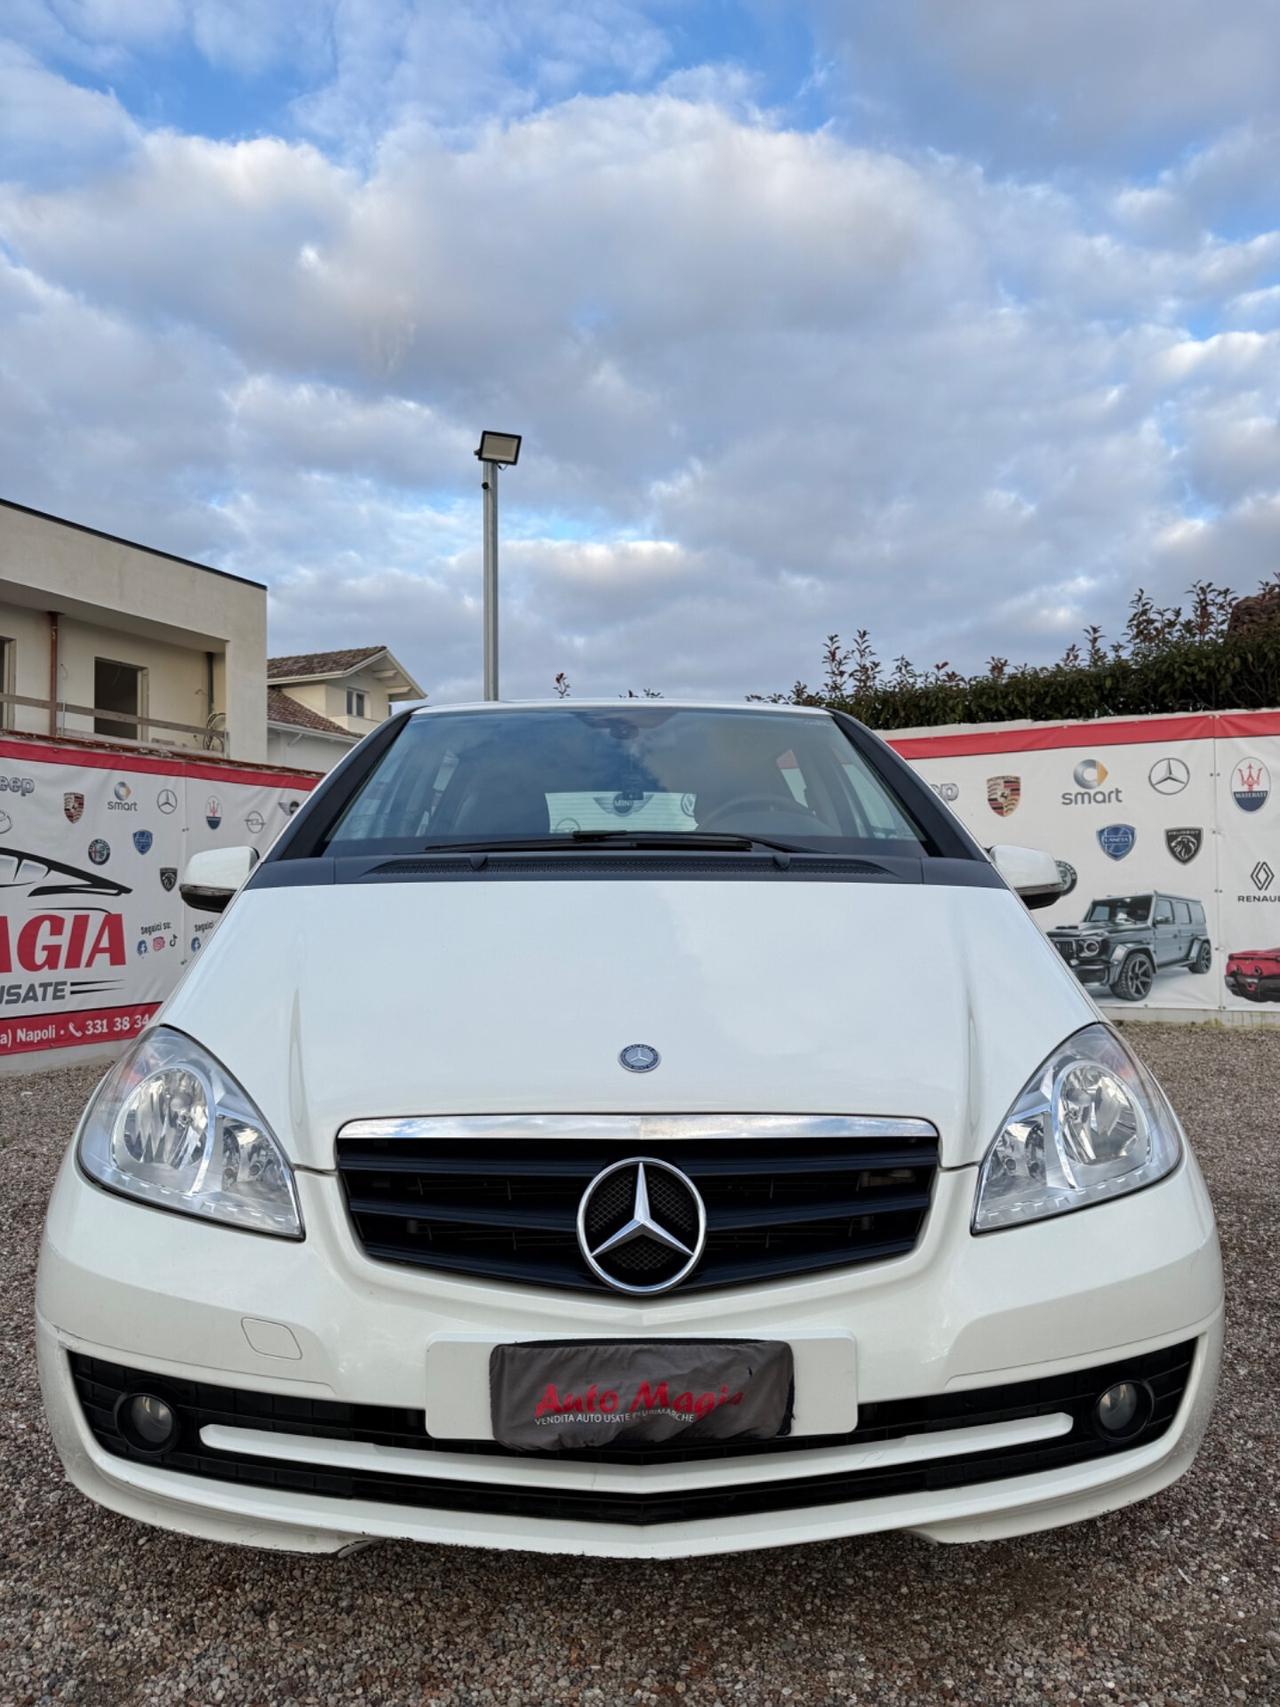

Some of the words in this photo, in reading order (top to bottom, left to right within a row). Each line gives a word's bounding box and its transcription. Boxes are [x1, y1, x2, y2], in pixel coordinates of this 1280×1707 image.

[1061, 788, 1123, 805] smart
[107, 801, 138, 812] smart
[16, 1024, 56, 1043] Napoli
[85, 1019, 108, 1035] 331
[113, 1017, 130, 1031] 38
[534, 1383, 618, 1417] Auto
[535, 1414, 574, 1426] VENDITA
[576, 1413, 602, 1423] AUTO
[603, 1413, 631, 1424] USATE
[632, 1408, 695, 1423] PUMARCHE
